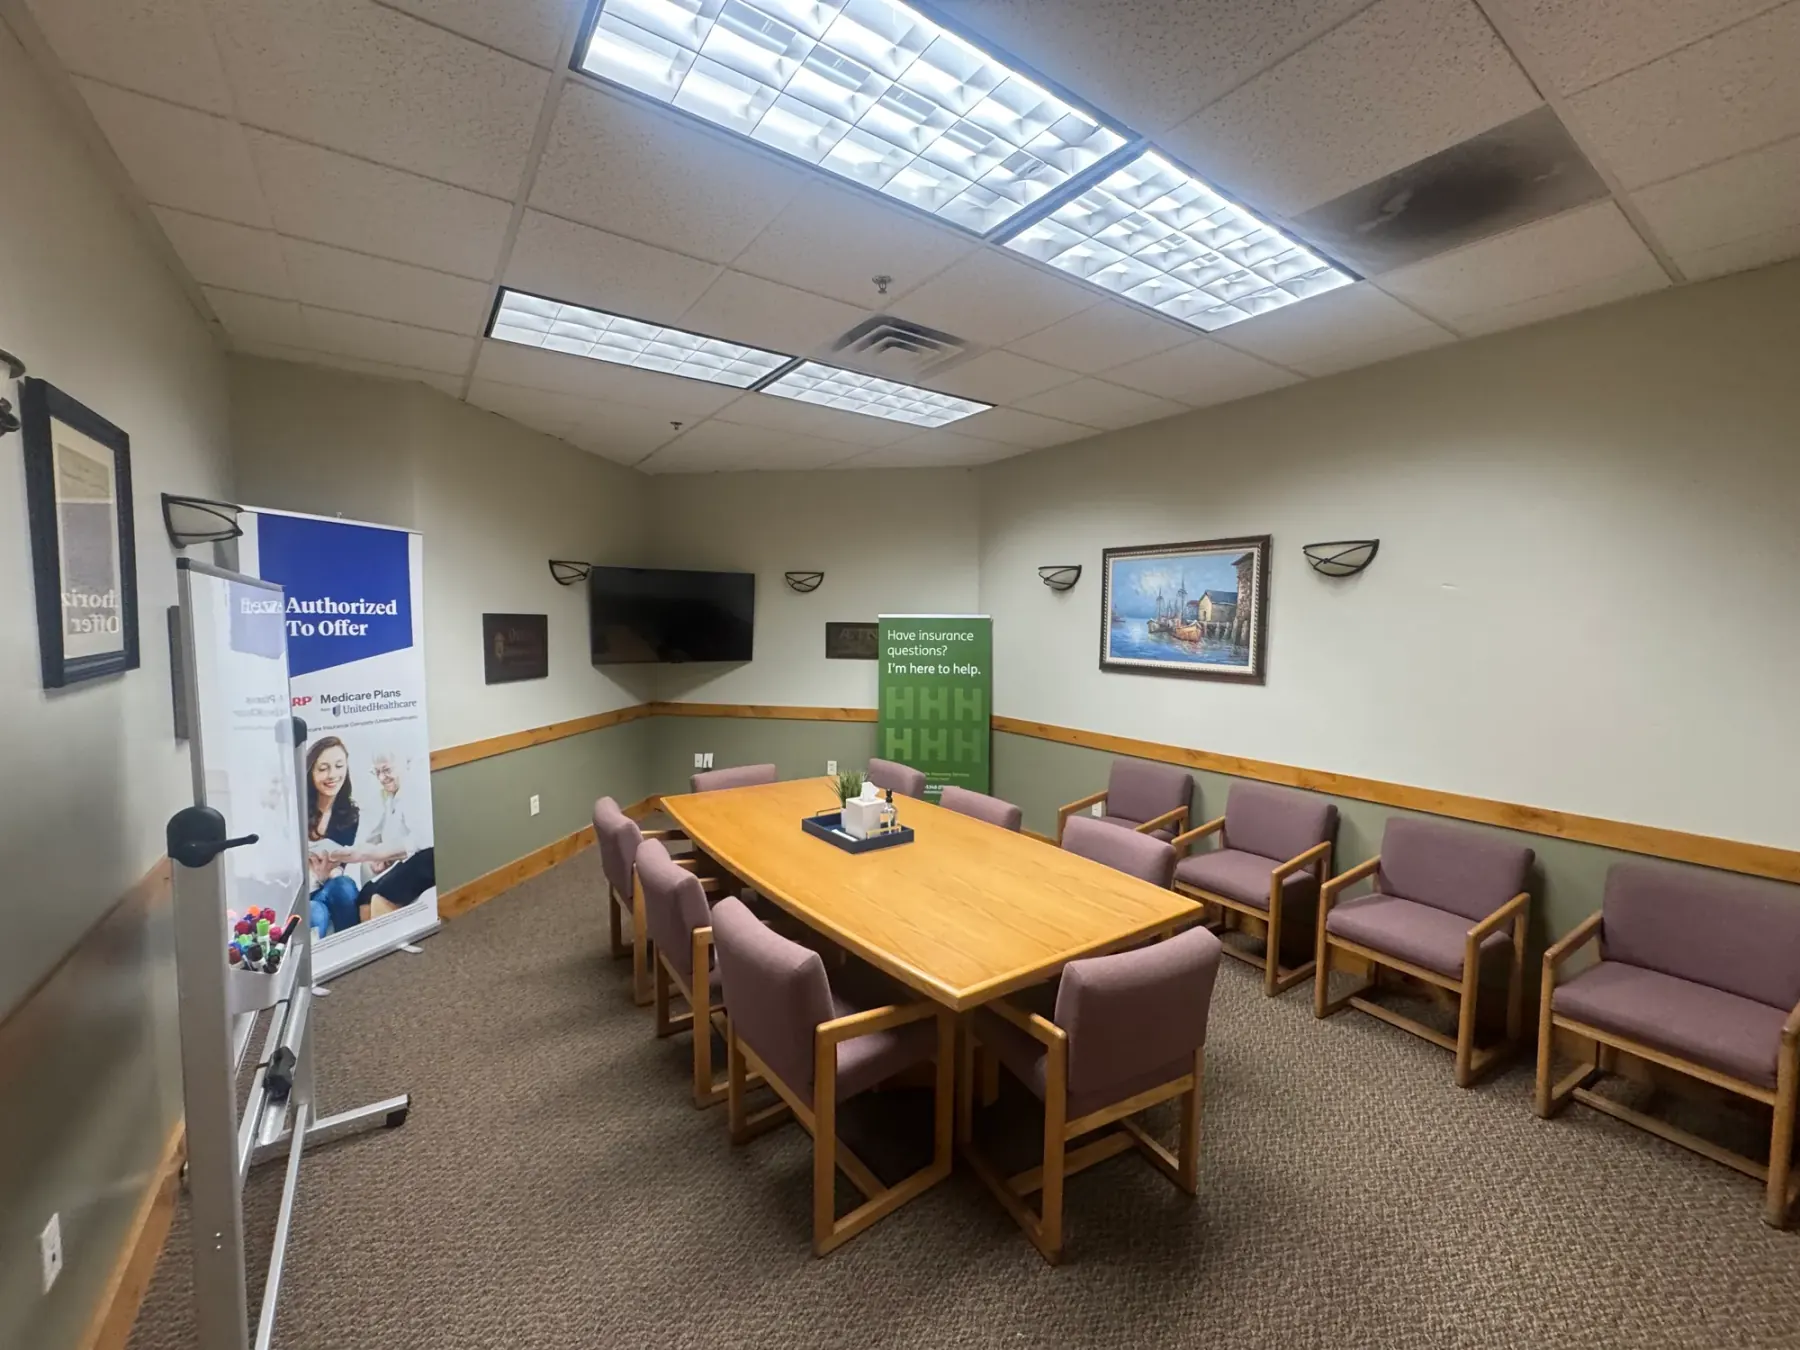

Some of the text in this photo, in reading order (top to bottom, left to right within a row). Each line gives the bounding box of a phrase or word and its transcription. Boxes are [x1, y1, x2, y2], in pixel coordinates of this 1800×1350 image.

[286, 597, 398, 615] Authorized
[286, 619, 369, 636] To Offer
[887, 629, 974, 641] Have insurance
[887, 645, 948, 658] questions?
[887, 662, 981, 677] I'm here to help.
[320, 691, 372, 704] Medicare
[373, 689, 402, 699] Plans
[343, 700, 417, 715] UnitedHealthcare
